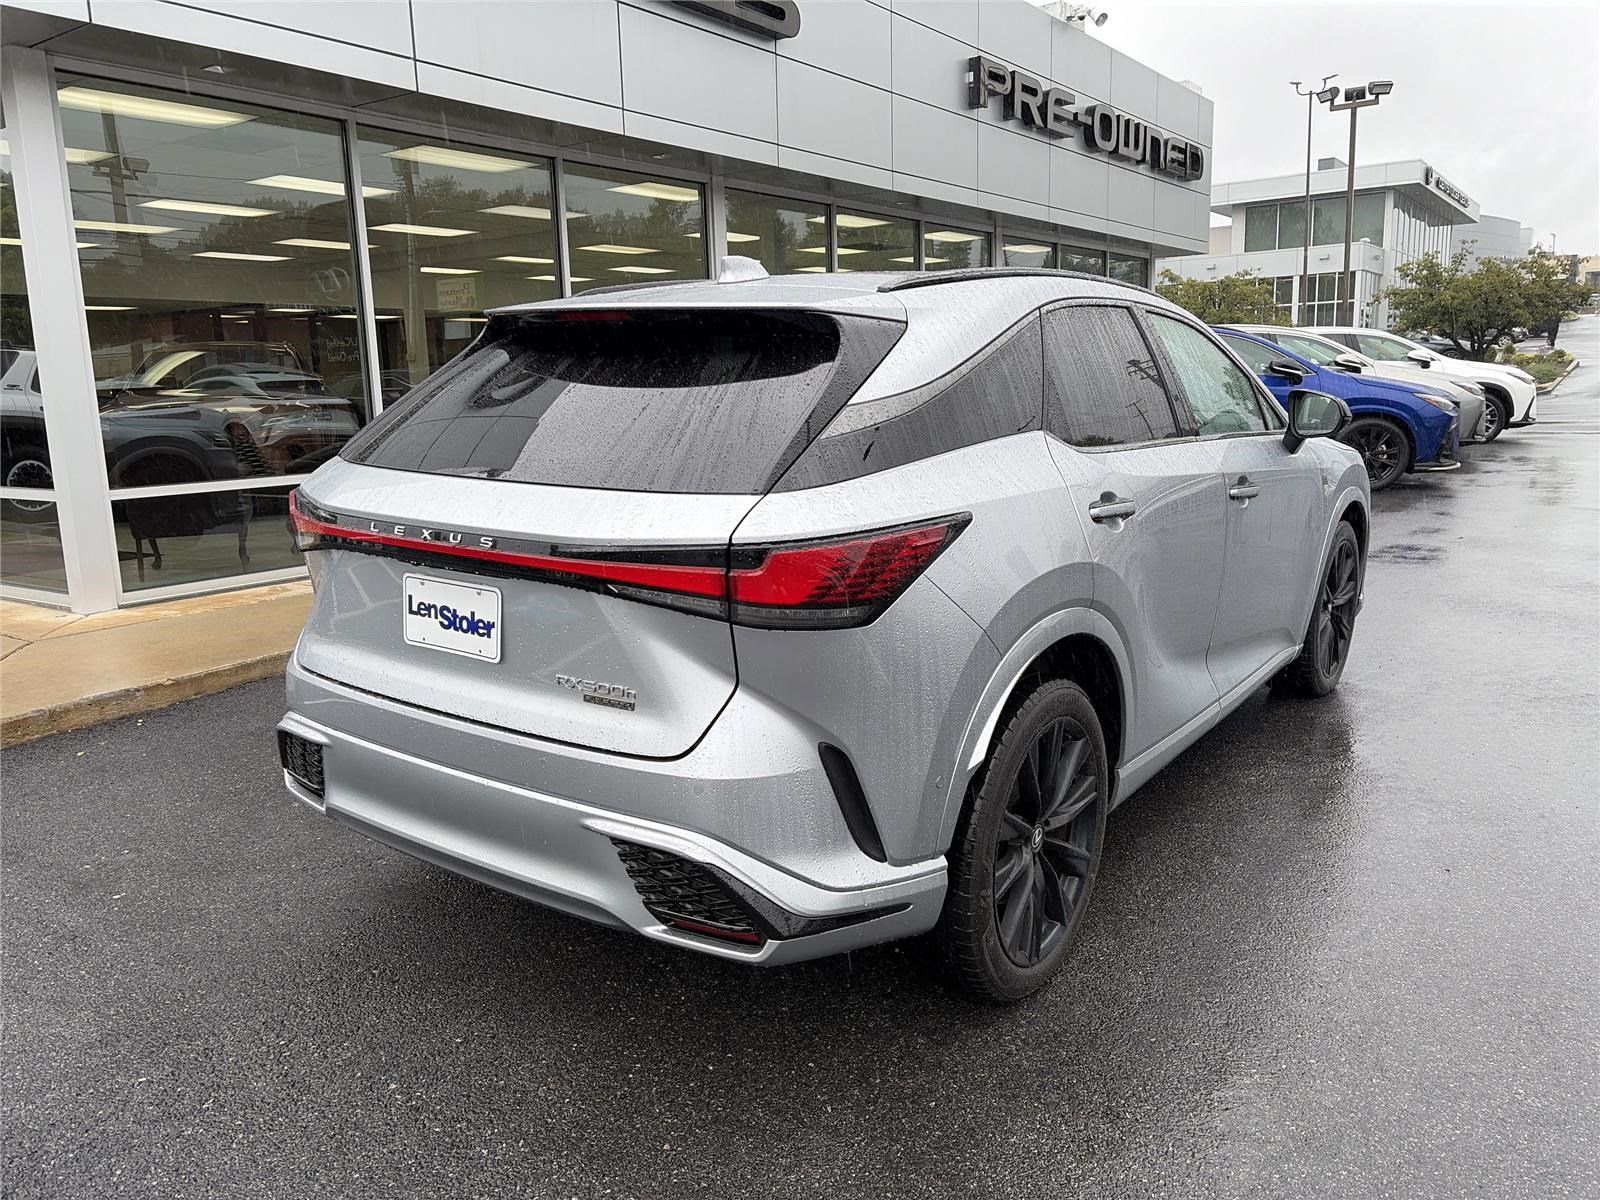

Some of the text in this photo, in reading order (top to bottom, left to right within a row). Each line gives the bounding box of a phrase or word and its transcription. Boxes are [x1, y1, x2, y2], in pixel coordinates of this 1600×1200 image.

[969, 55, 1204, 182] PRE-OWNED
[370, 522, 493, 548] LEXUS
[555, 674, 636, 700] RX500h
